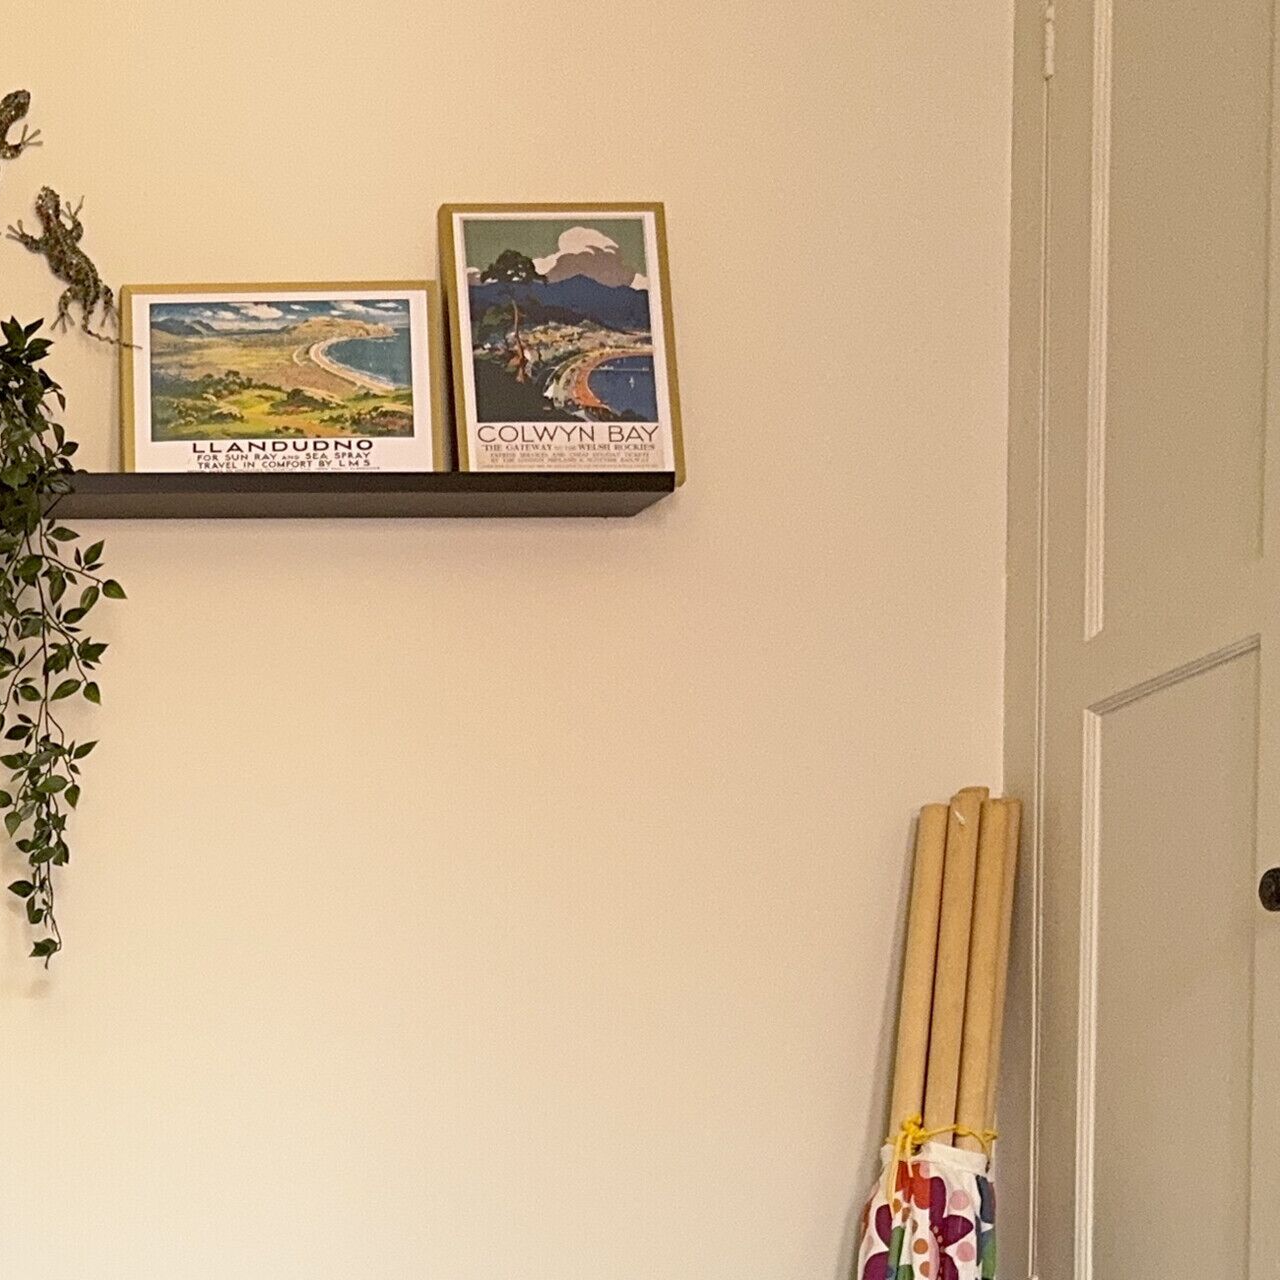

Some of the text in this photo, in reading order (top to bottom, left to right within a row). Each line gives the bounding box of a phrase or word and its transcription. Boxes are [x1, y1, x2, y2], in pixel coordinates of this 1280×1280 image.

[477, 425, 659, 443] COLWYN BAY
[192, 439, 373, 454] LLANDUDNO
[578, 443, 611, 451] WELSH
[225, 453, 248, 461] SUN
[254, 453, 278, 461] RAY
[305, 452, 328, 460] SEA
[334, 452, 371, 460] SPRAY
[198, 461, 237, 469] TRAVEL
[244, 461, 255, 469] IN
[261, 460, 312, 468] COMFORT
[318, 459, 332, 467] BY
